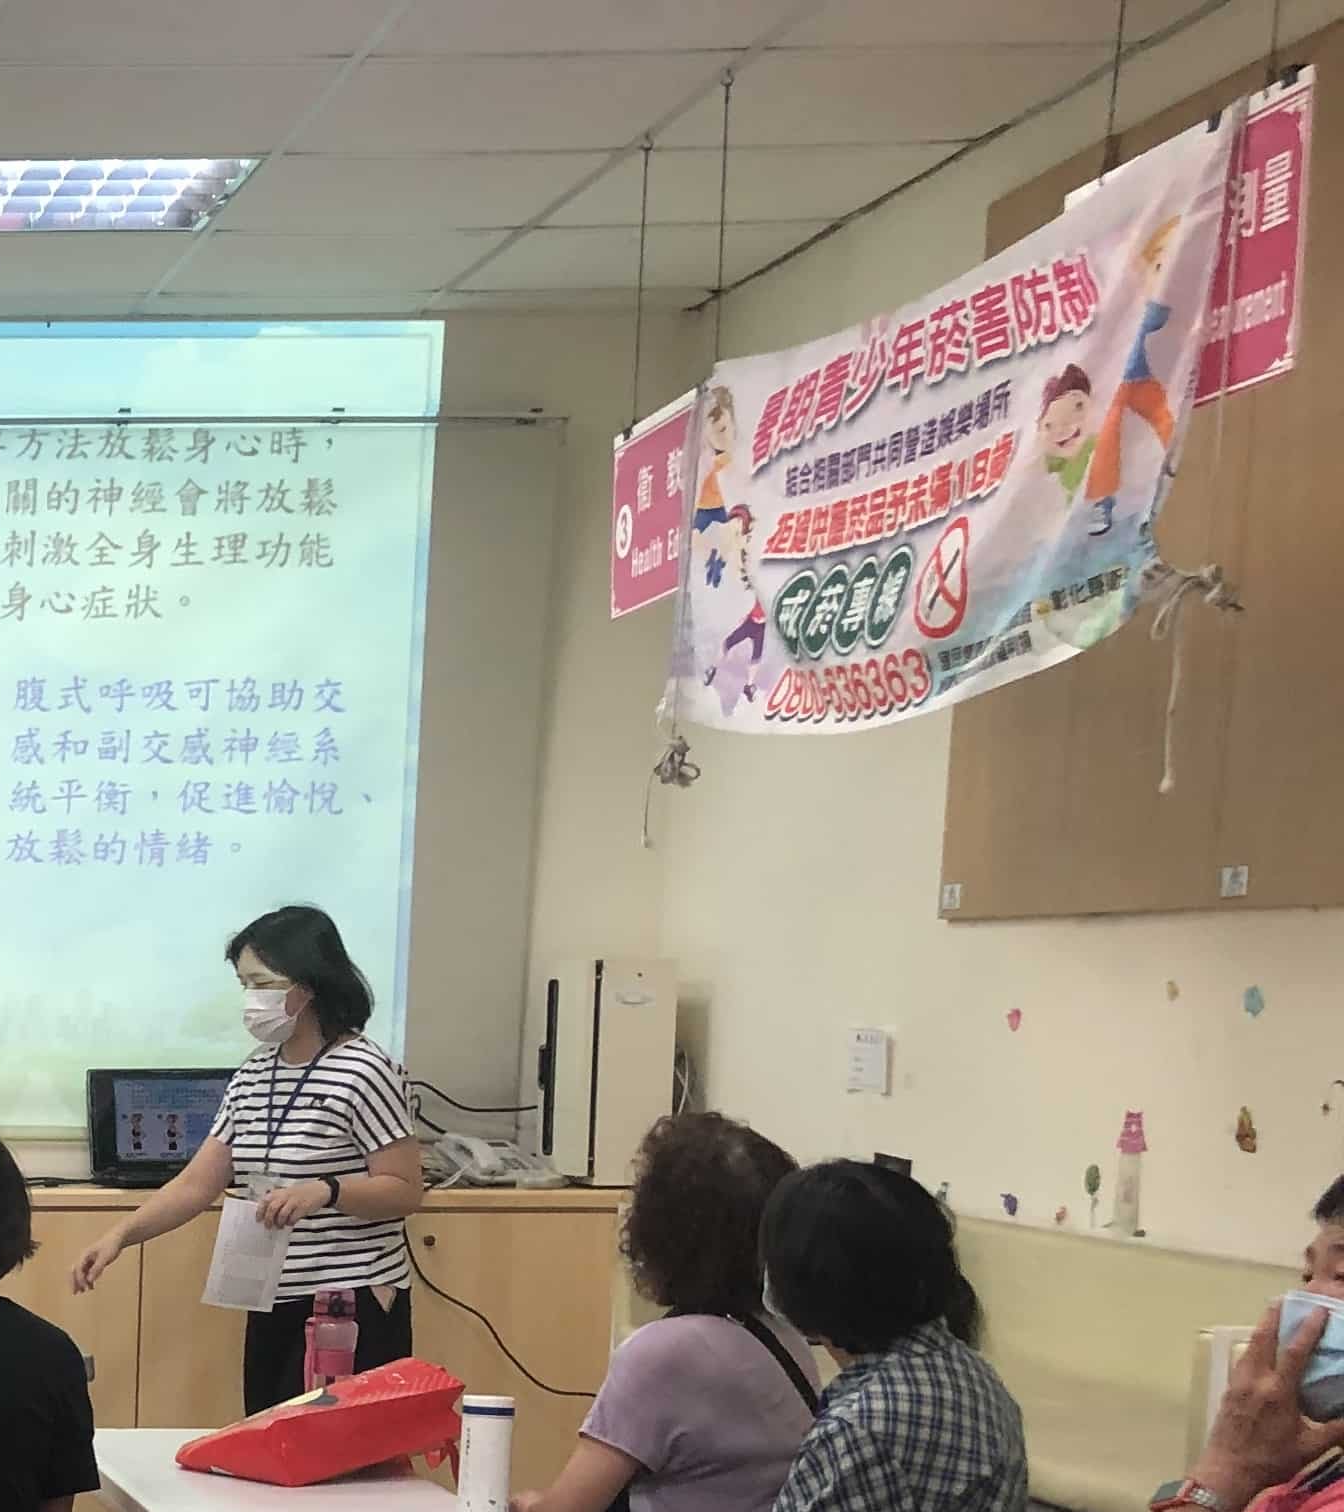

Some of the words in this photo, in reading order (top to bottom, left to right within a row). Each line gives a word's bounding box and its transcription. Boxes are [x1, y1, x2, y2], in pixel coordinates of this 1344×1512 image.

[751, 253, 1099, 470] 暑期青少年菸害防制
[631, 536, 664, 578] Health
[777, 566, 907, 642] 戒菸專線
[13, 675, 346, 714] 腹式呼吸可協助交
[766, 647, 931, 715] 0800-636363
[10, 727, 343, 767] 感和副交感神經系
[8, 778, 372, 816] 統平衡，促進愉悅、
[6, 828, 242, 868] 放鬆的情緒。
